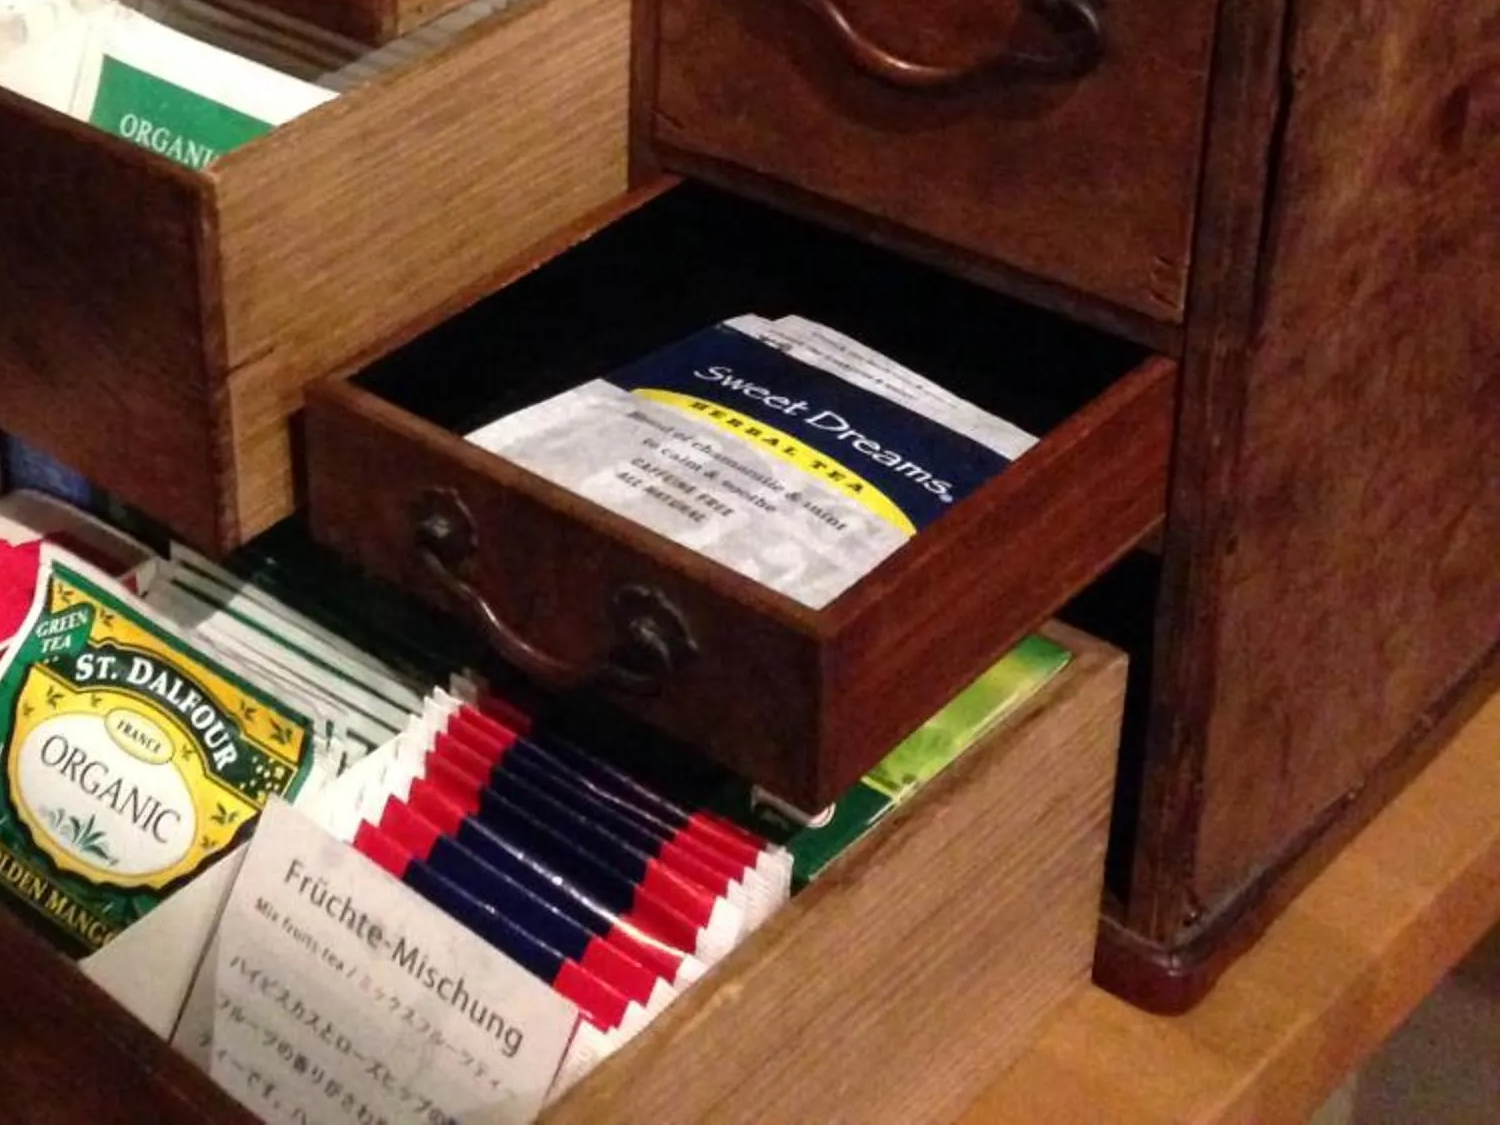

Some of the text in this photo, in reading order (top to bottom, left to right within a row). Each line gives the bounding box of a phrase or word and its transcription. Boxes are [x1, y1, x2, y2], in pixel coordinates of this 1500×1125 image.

[119, 112, 221, 172] ORGANI
[693, 364, 809, 417] Sweet
[687, 400, 865, 495] HERBAL TEA
[36, 606, 89, 639] GREEN
[41, 634, 73, 654] TEA
[74, 652, 239, 772] ST. DALFOUR
[116, 719, 163, 756] FRANCE
[40, 734, 181, 845] ORGANIC
[283, 859, 526, 1060] Früchte-Mischung
